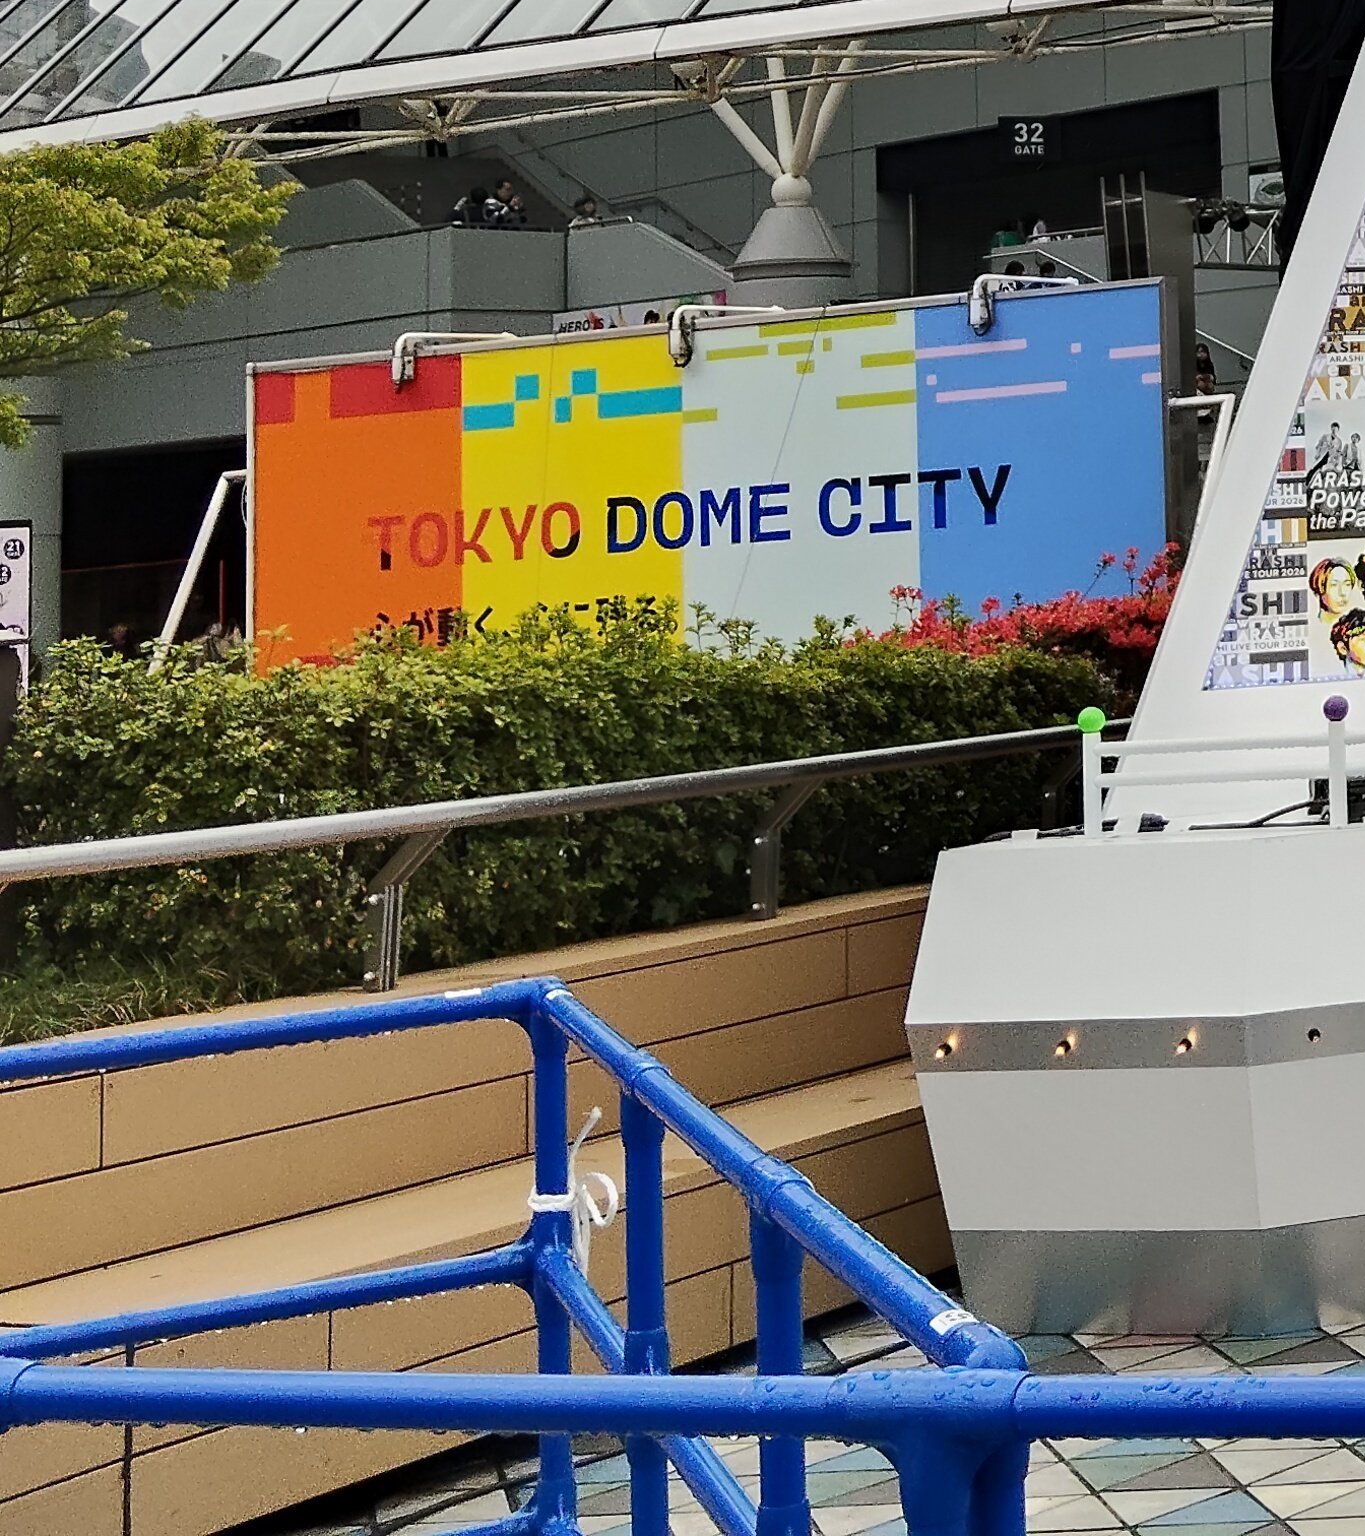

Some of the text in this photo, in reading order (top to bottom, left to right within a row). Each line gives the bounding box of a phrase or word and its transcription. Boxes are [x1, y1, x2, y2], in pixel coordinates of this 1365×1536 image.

[1014, 122, 1045, 143] 32
[1014, 145, 1045, 155] GATE
[1330, 354, 1364, 363] ARASHI
[368, 465, 1012, 571] TOKYO DOME CITY
[1310, 513, 1336, 530] the
[1252, 567, 1305, 578] TOUR 2026
[1230, 643, 1251, 652] LIVE
[1254, 641, 1280, 650] TOUR
[1283, 640, 1306, 648] 2026
